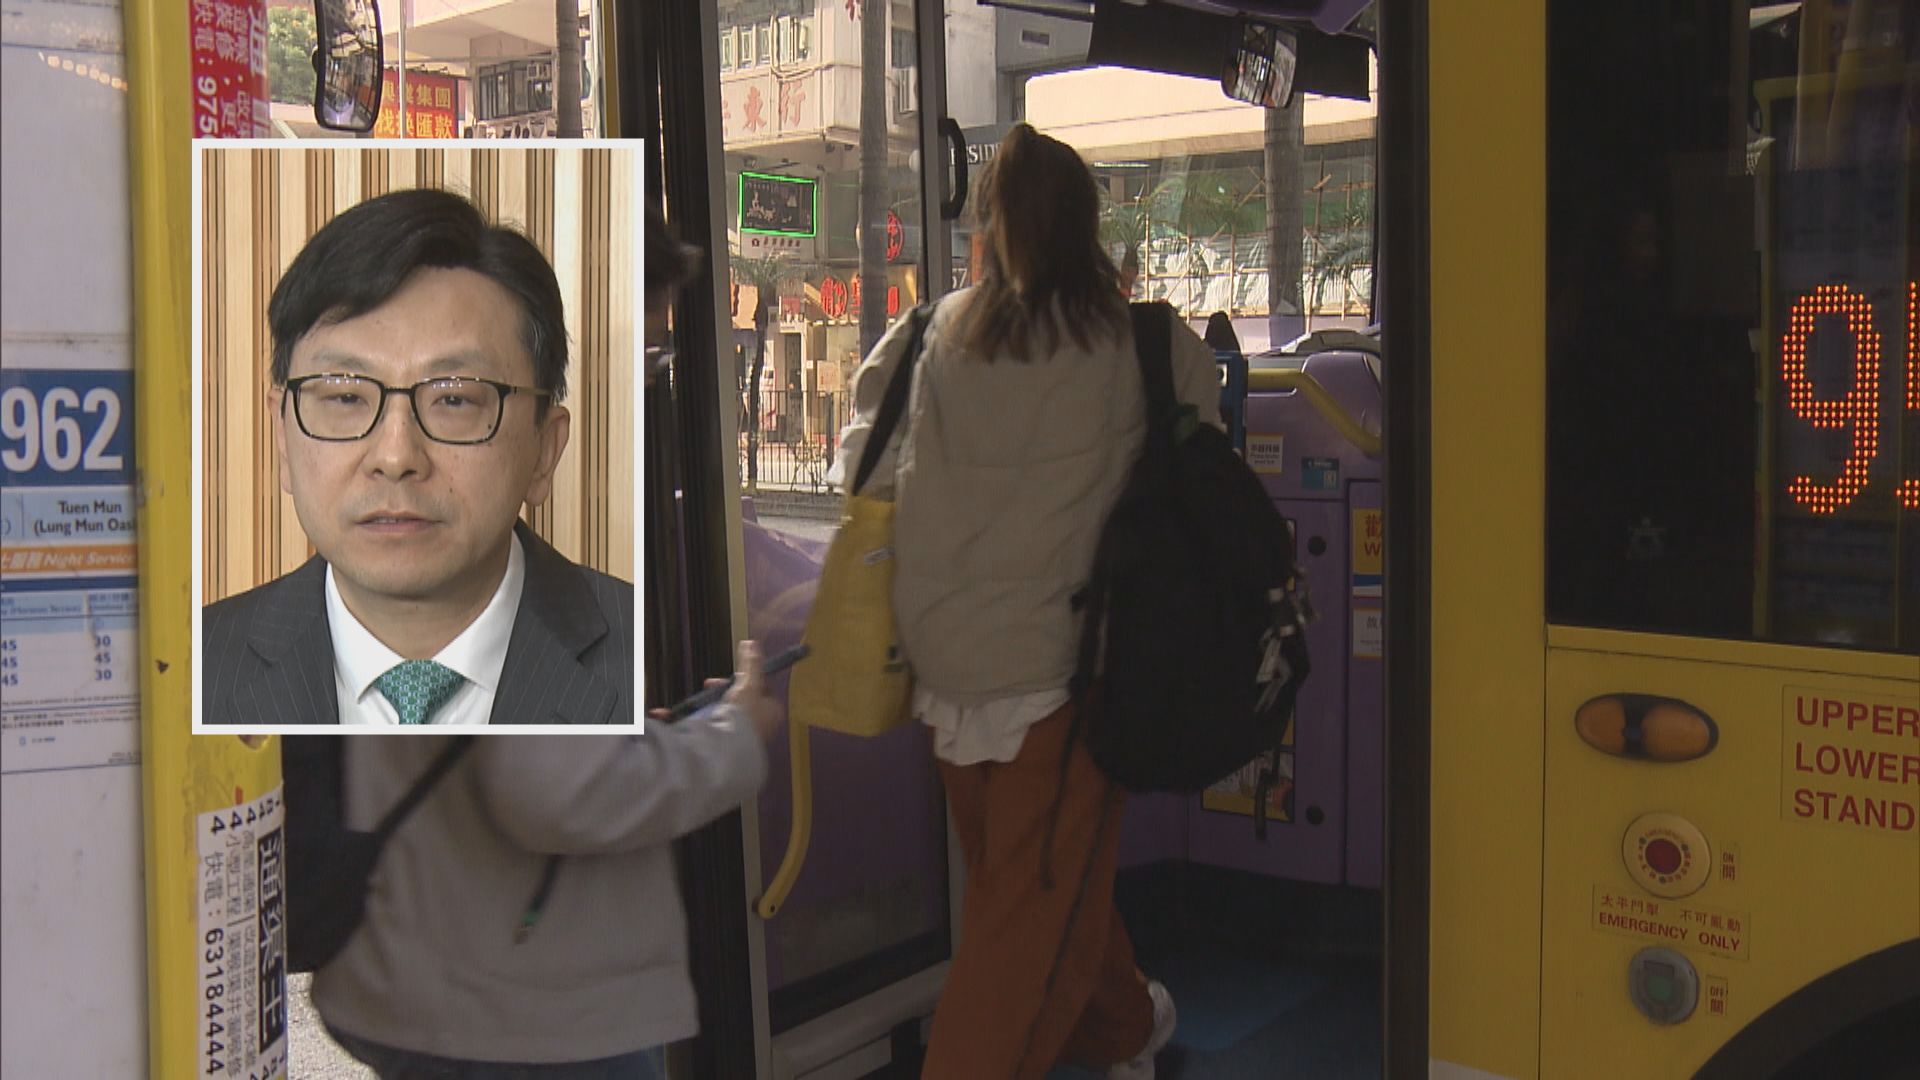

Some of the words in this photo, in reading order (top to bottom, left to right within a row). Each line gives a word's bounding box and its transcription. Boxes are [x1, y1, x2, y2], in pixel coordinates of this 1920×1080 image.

[198, 76, 219, 138] 975
[1783, 283, 1920, 514] 9
[1, 386, 123, 472] 962
[58, 501, 90, 514] Tuen
[94, 501, 122, 514] Mun
[34, 520, 72, 537] (Lung
[75, 519, 104, 533] Mun
[1, 639, 17, 651] 45
[1, 656, 18, 669] 45
[94, 652, 111, 664] 45
[1, 674, 18, 686] 45
[1796, 695, 1920, 737] UPPER
[1795, 741, 1920, 785] LOWER
[1793, 787, 1916, 832] STAND
[1722, 852, 1734, 864] ON
[1599, 911, 1688, 941] EMERGENCY
[1698, 931, 1740, 951] ONLY
[205, 927, 224, 1076] 63184444
